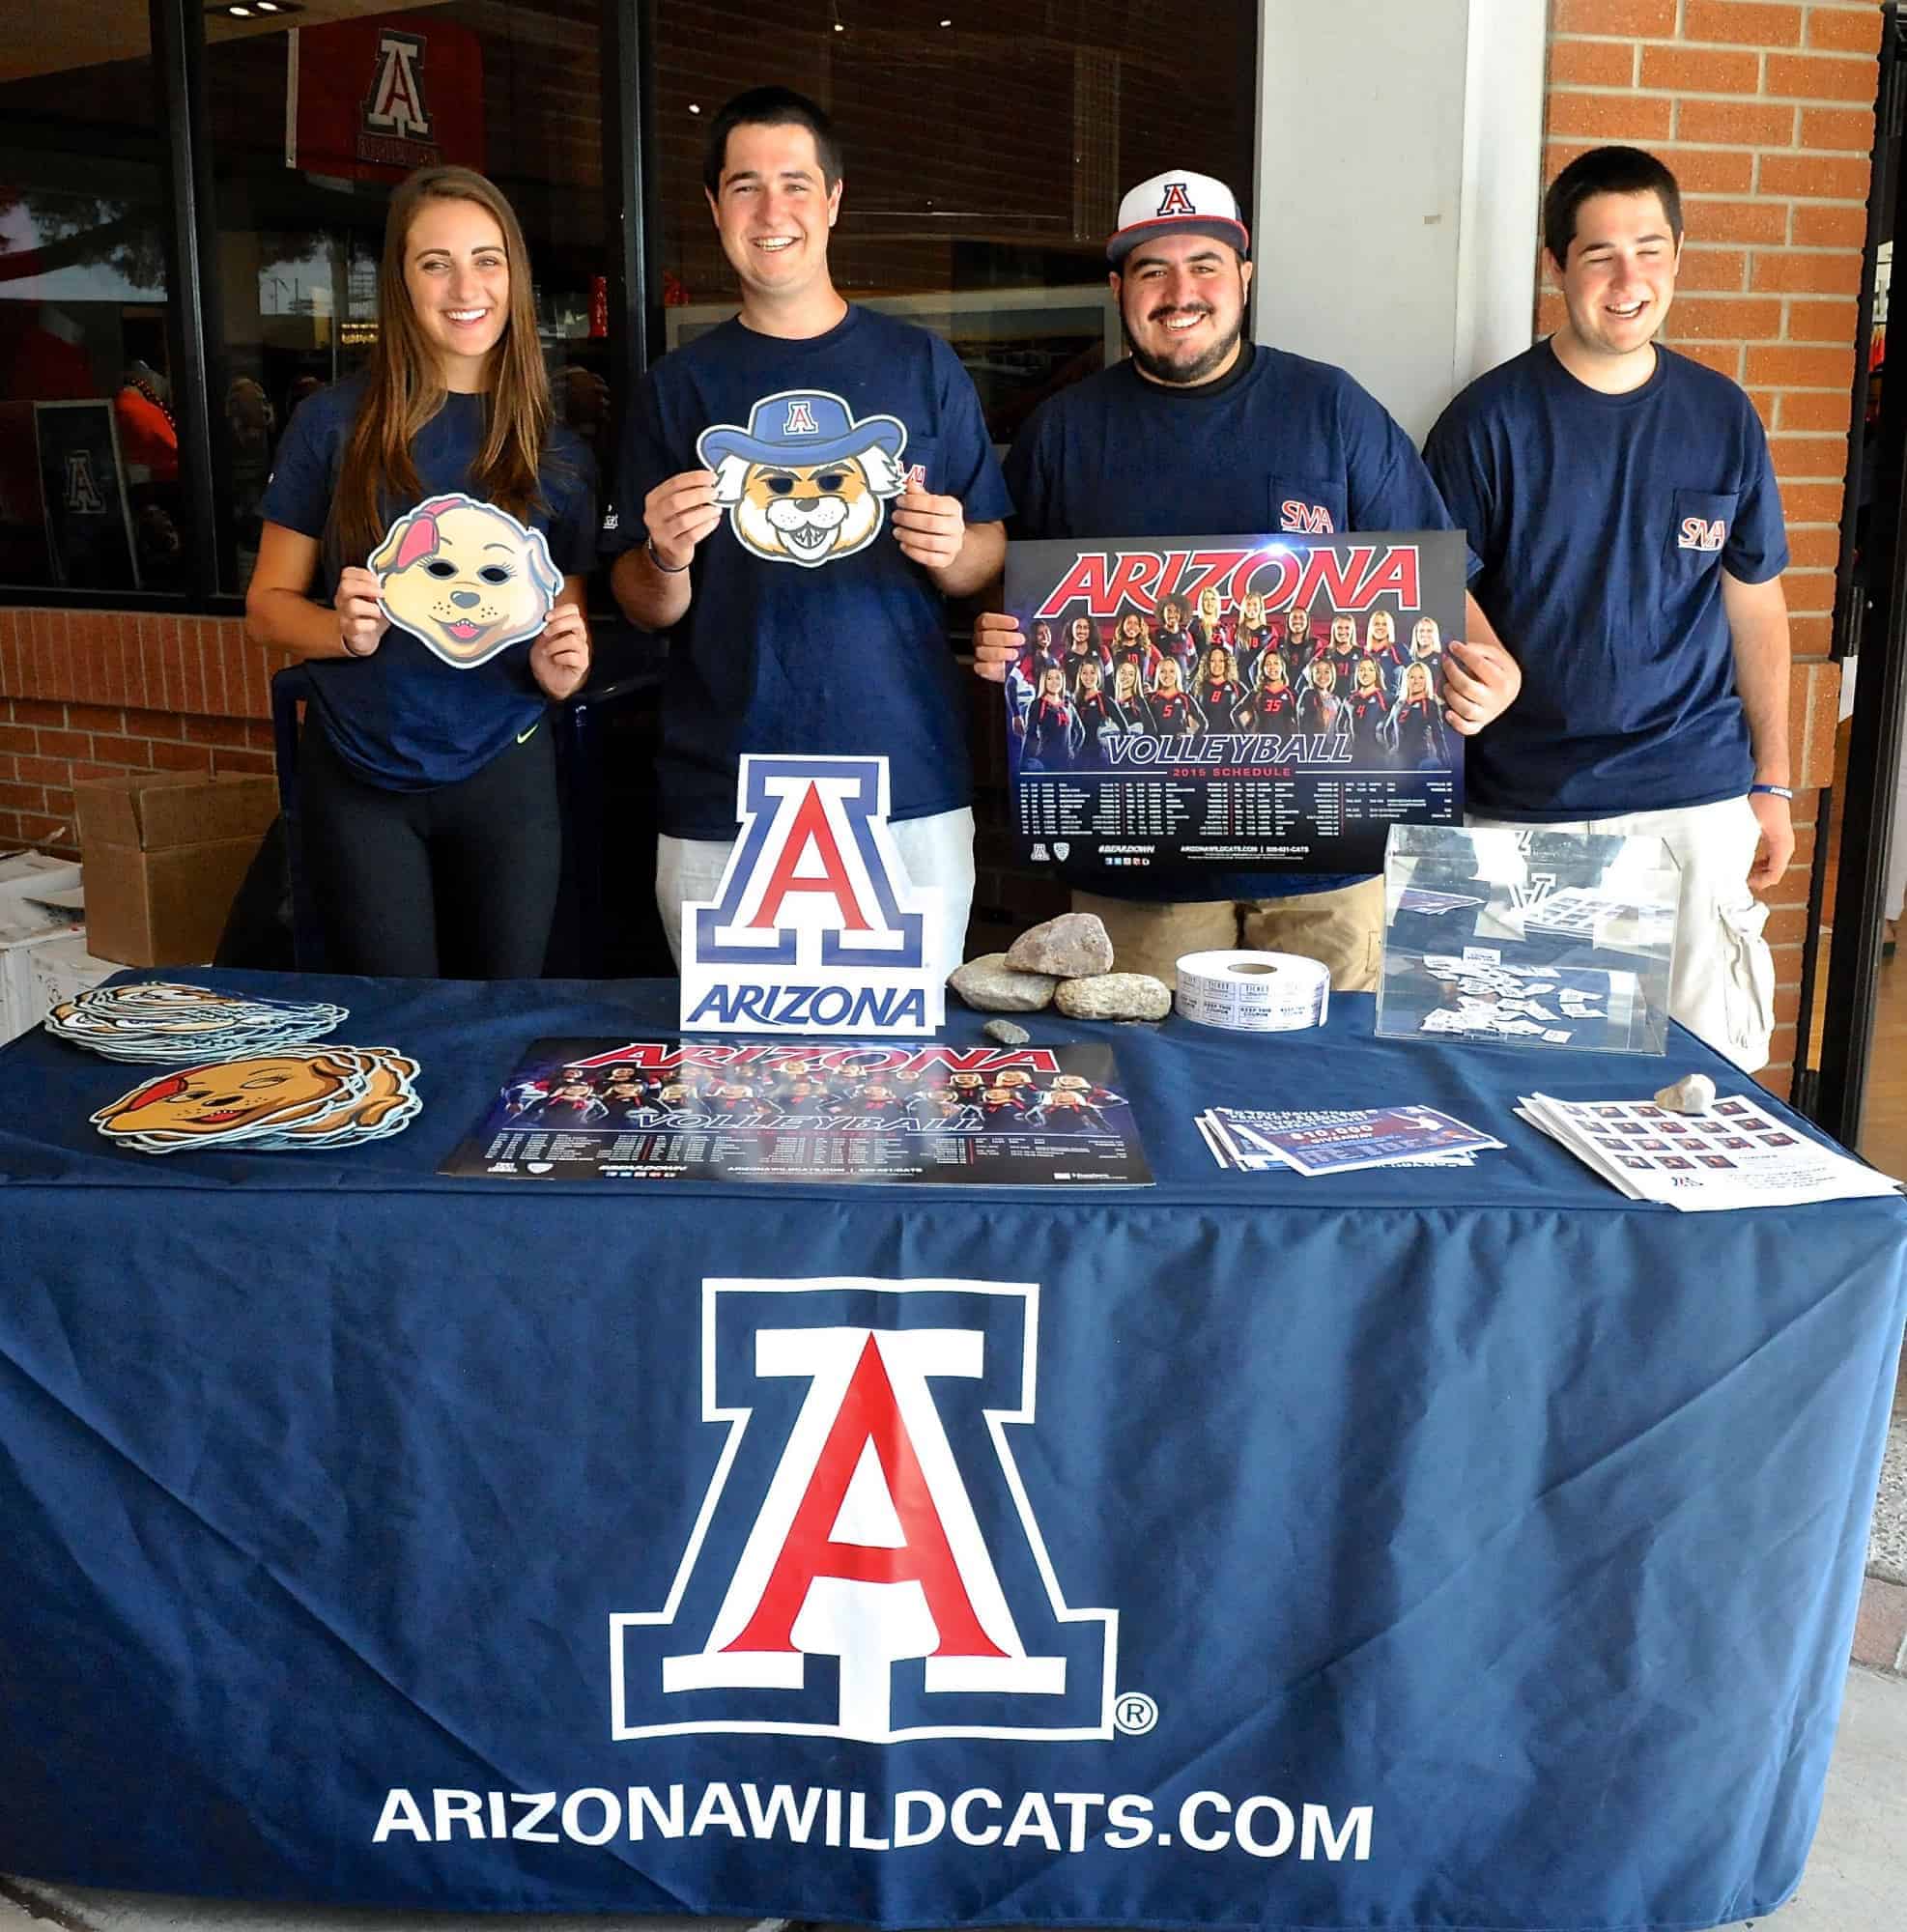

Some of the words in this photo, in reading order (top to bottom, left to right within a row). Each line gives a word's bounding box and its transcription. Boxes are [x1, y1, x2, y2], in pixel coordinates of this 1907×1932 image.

[1156, 183, 1196, 216] A
[782, 401, 819, 435] A
[1034, 545, 1420, 619] ARIZONA
[1162, 705, 1174, 718] 5
[1210, 691, 1222, 702] 8
[1264, 698, 1282, 712] 35
[1104, 733, 1352, 765] VOLLEYBALL
[1172, 768, 1207, 778] 2015
[1212, 768, 1292, 778] SCHEDULE
[697, 759, 924, 968] A
[685, 984, 925, 1027] ARIZONA
[563, 1042, 1061, 1073] ARIZONA
[638, 1113, 983, 1132] VOLLEYBALL
[1290, 1123, 1374, 1142] $10,000
[610, 1276, 1119, 1744] A
[370, 1781, 1374, 1861] ARIZONAWILDCATS.COM
